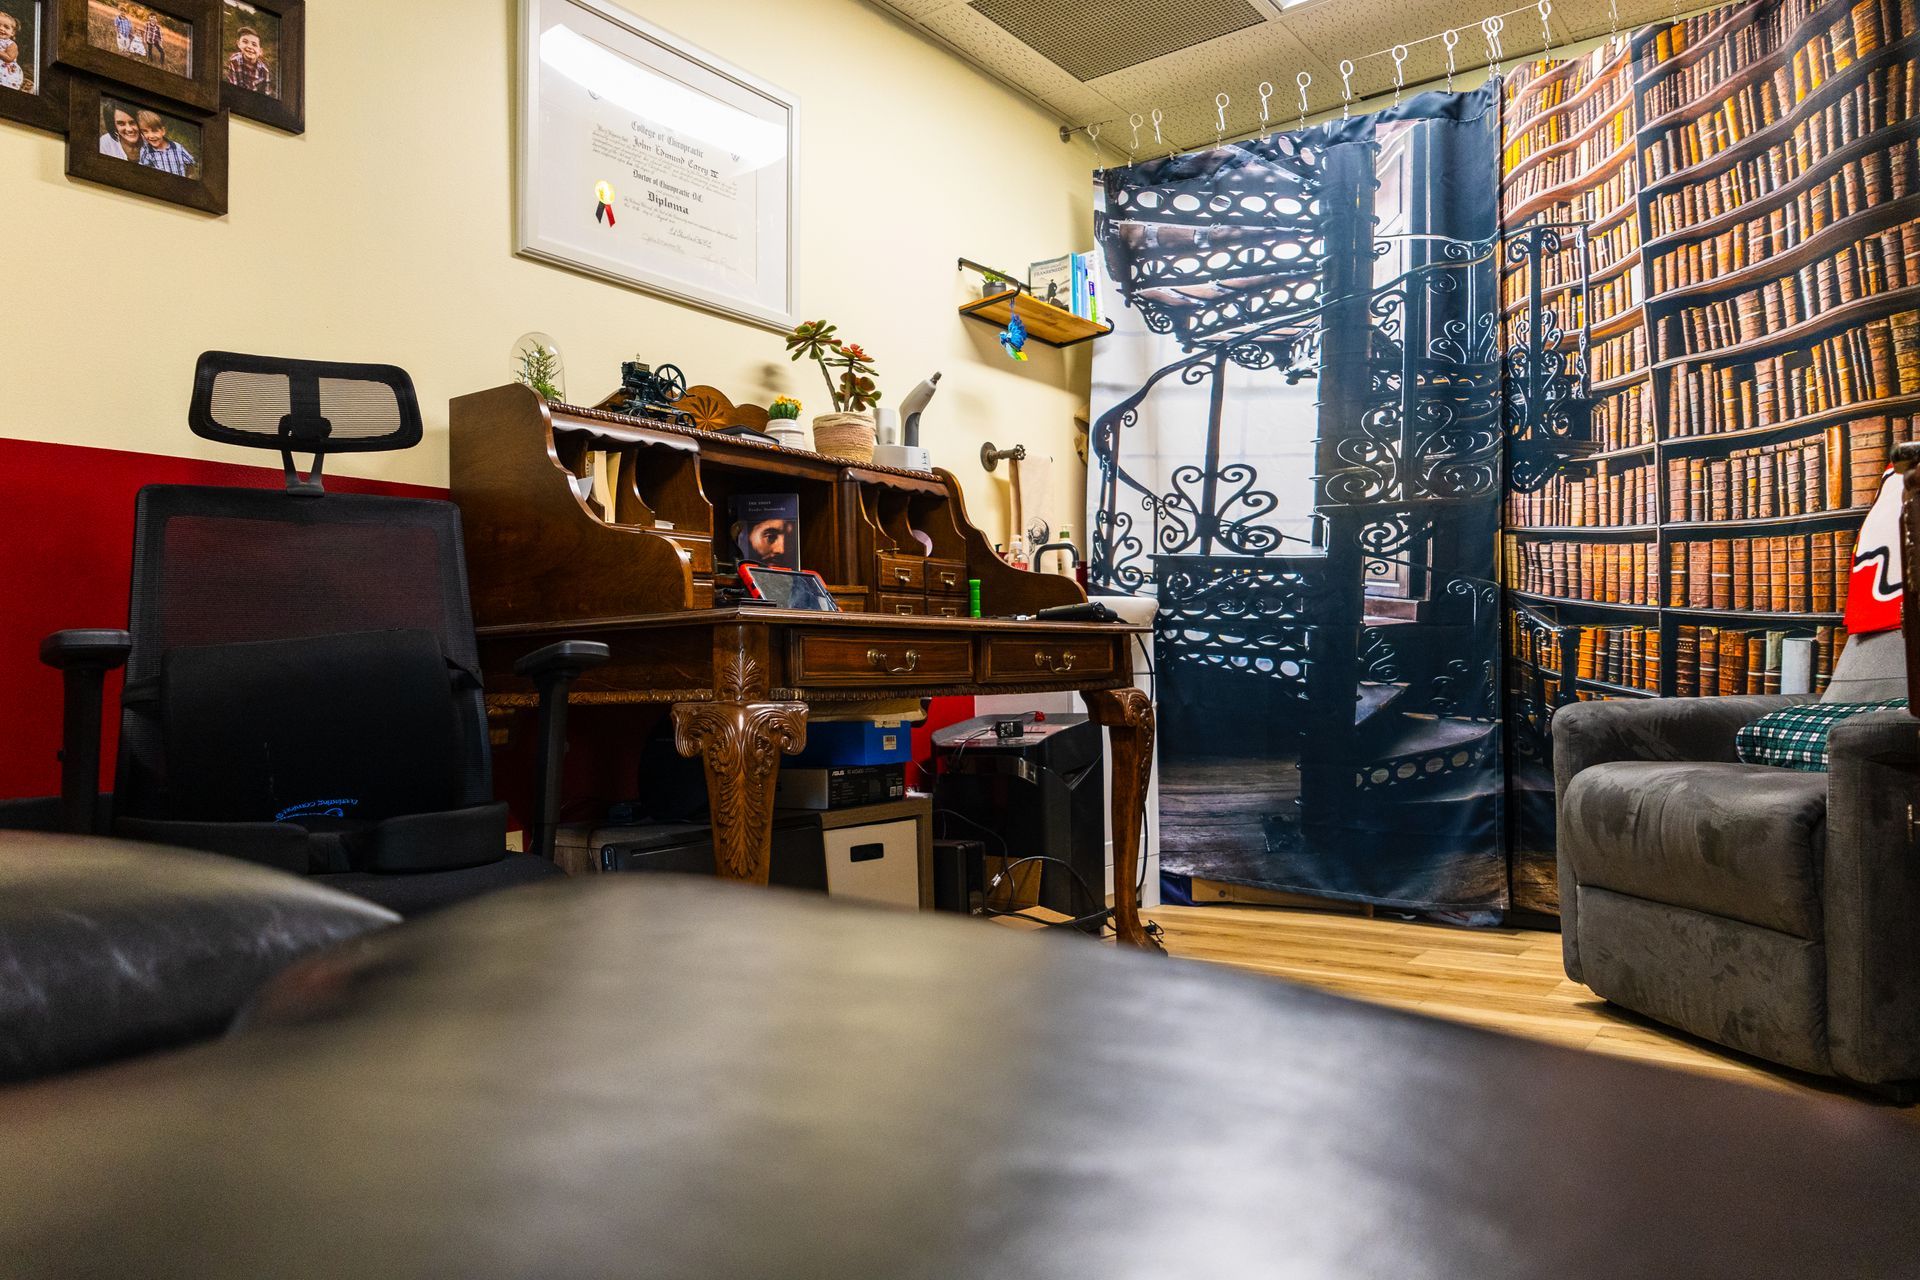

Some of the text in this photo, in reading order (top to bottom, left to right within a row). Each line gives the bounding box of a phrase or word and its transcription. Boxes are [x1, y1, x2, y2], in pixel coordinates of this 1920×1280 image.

[631, 121, 703, 158] College of Chiropractic
[633, 135, 652, 152] John
[655, 144, 685, 164] Edmund
[633, 169, 651, 184] Doctor
[653, 178, 659, 186] of
[660, 180, 690, 198] Chiropractic
[647, 191, 689, 215] Diploma
